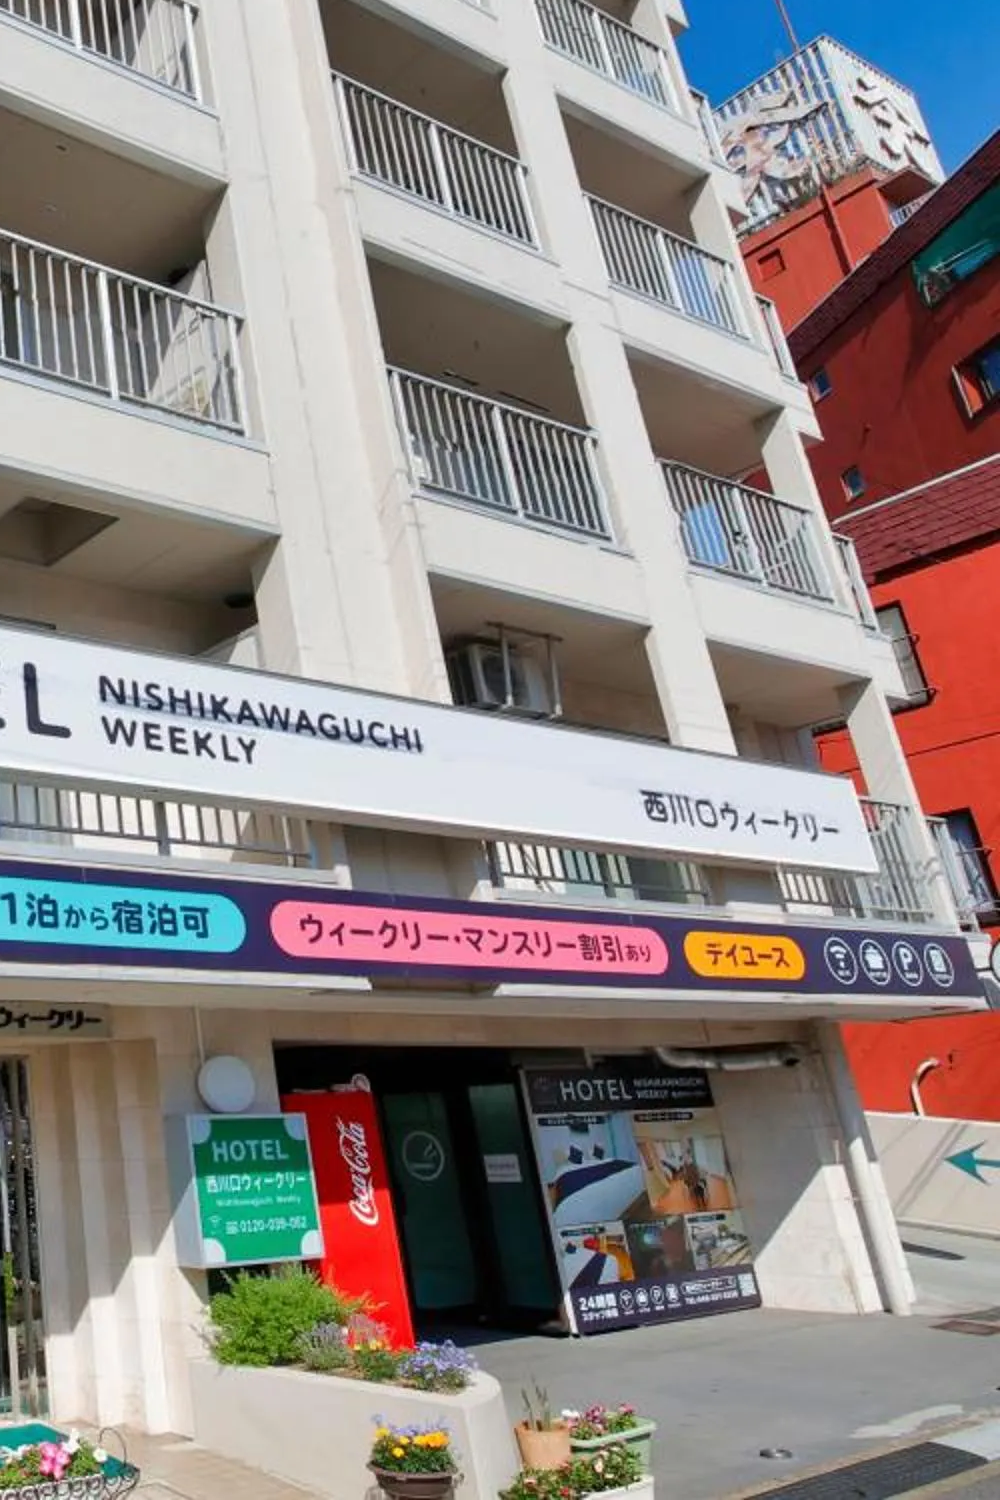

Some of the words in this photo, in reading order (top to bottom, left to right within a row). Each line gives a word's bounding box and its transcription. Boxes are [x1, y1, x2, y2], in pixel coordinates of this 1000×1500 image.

[98, 675, 424, 755] NISHIKAWAGUCHI
[101, 715, 258, 765] WEEKLY
[641, 789, 839, 843] 西川口ウィークリー
[0, 888, 211, 942] 1泊から宿泊可
[704, 941, 792, 972] デイユース
[559, 1078, 633, 1101] HOTEL
[211, 1139, 290, 1163] HOTEL
